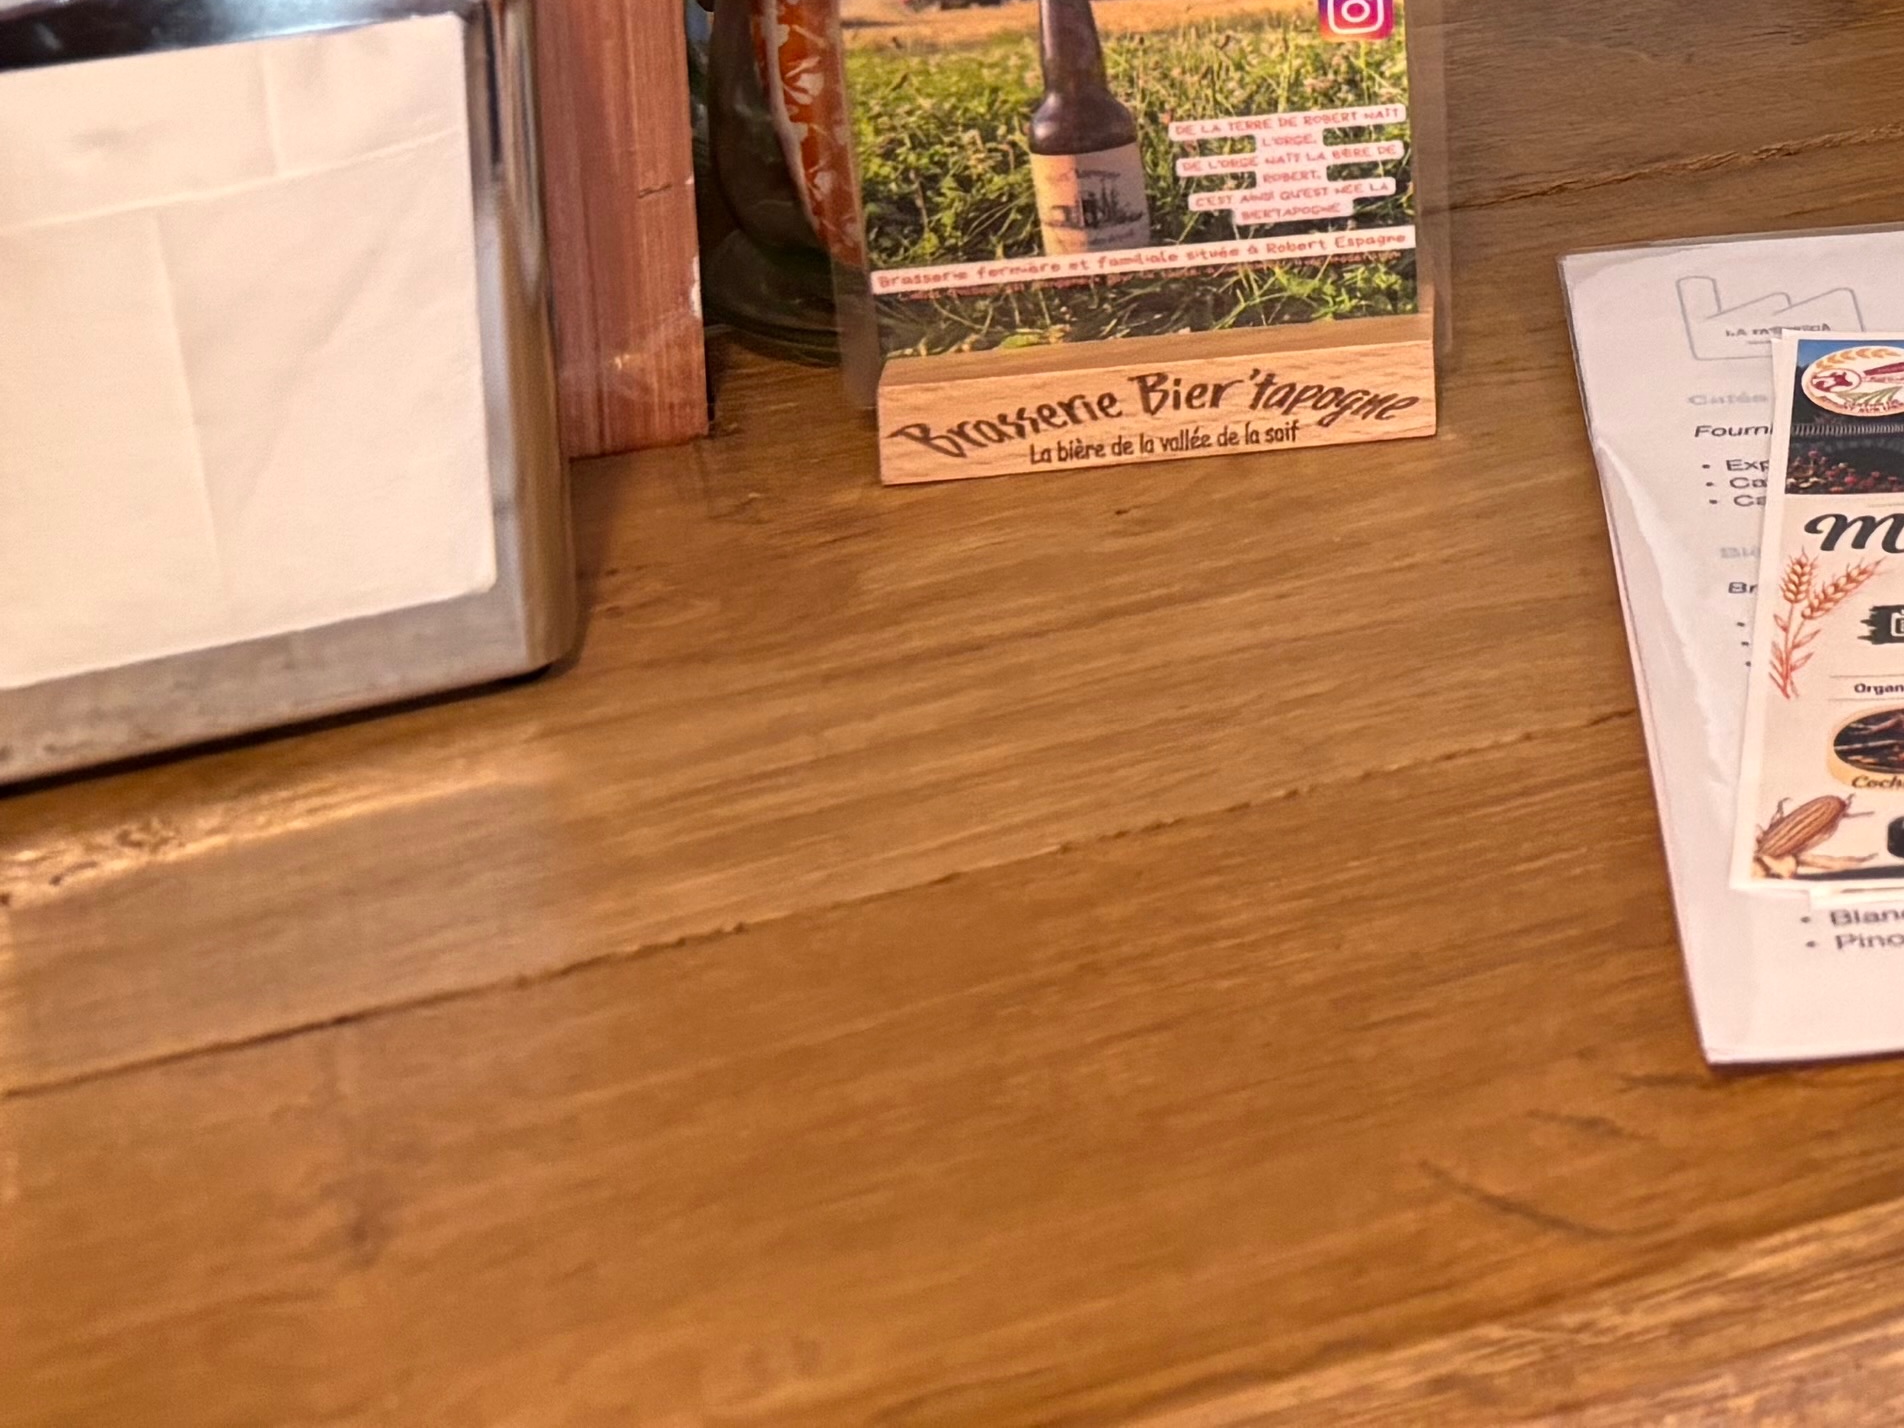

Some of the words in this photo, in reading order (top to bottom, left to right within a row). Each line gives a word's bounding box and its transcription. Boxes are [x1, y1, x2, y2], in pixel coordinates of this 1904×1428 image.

[1304, 111, 1357, 125] ROBERT
[877, 270, 968, 289] Brasserie
[1068, 257, 1091, 271] et
[1097, 246, 1178, 271] familiale
[1247, 242, 1260, 256] à
[1266, 238, 1327, 254] Robert
[1334, 232, 1407, 250] Espagne
[886, 390, 1125, 460] Brasserie
[1028, 444, 1054, 467] La
[1057, 438, 1108, 464] bière
[1110, 435, 1135, 458] de
[1138, 431, 1157, 454] la
[1158, 425, 1214, 452] vallée
[1216, 425, 1240, 447] de
[1242, 422, 1262, 445] la
[1263, 419, 1300, 445] soif
